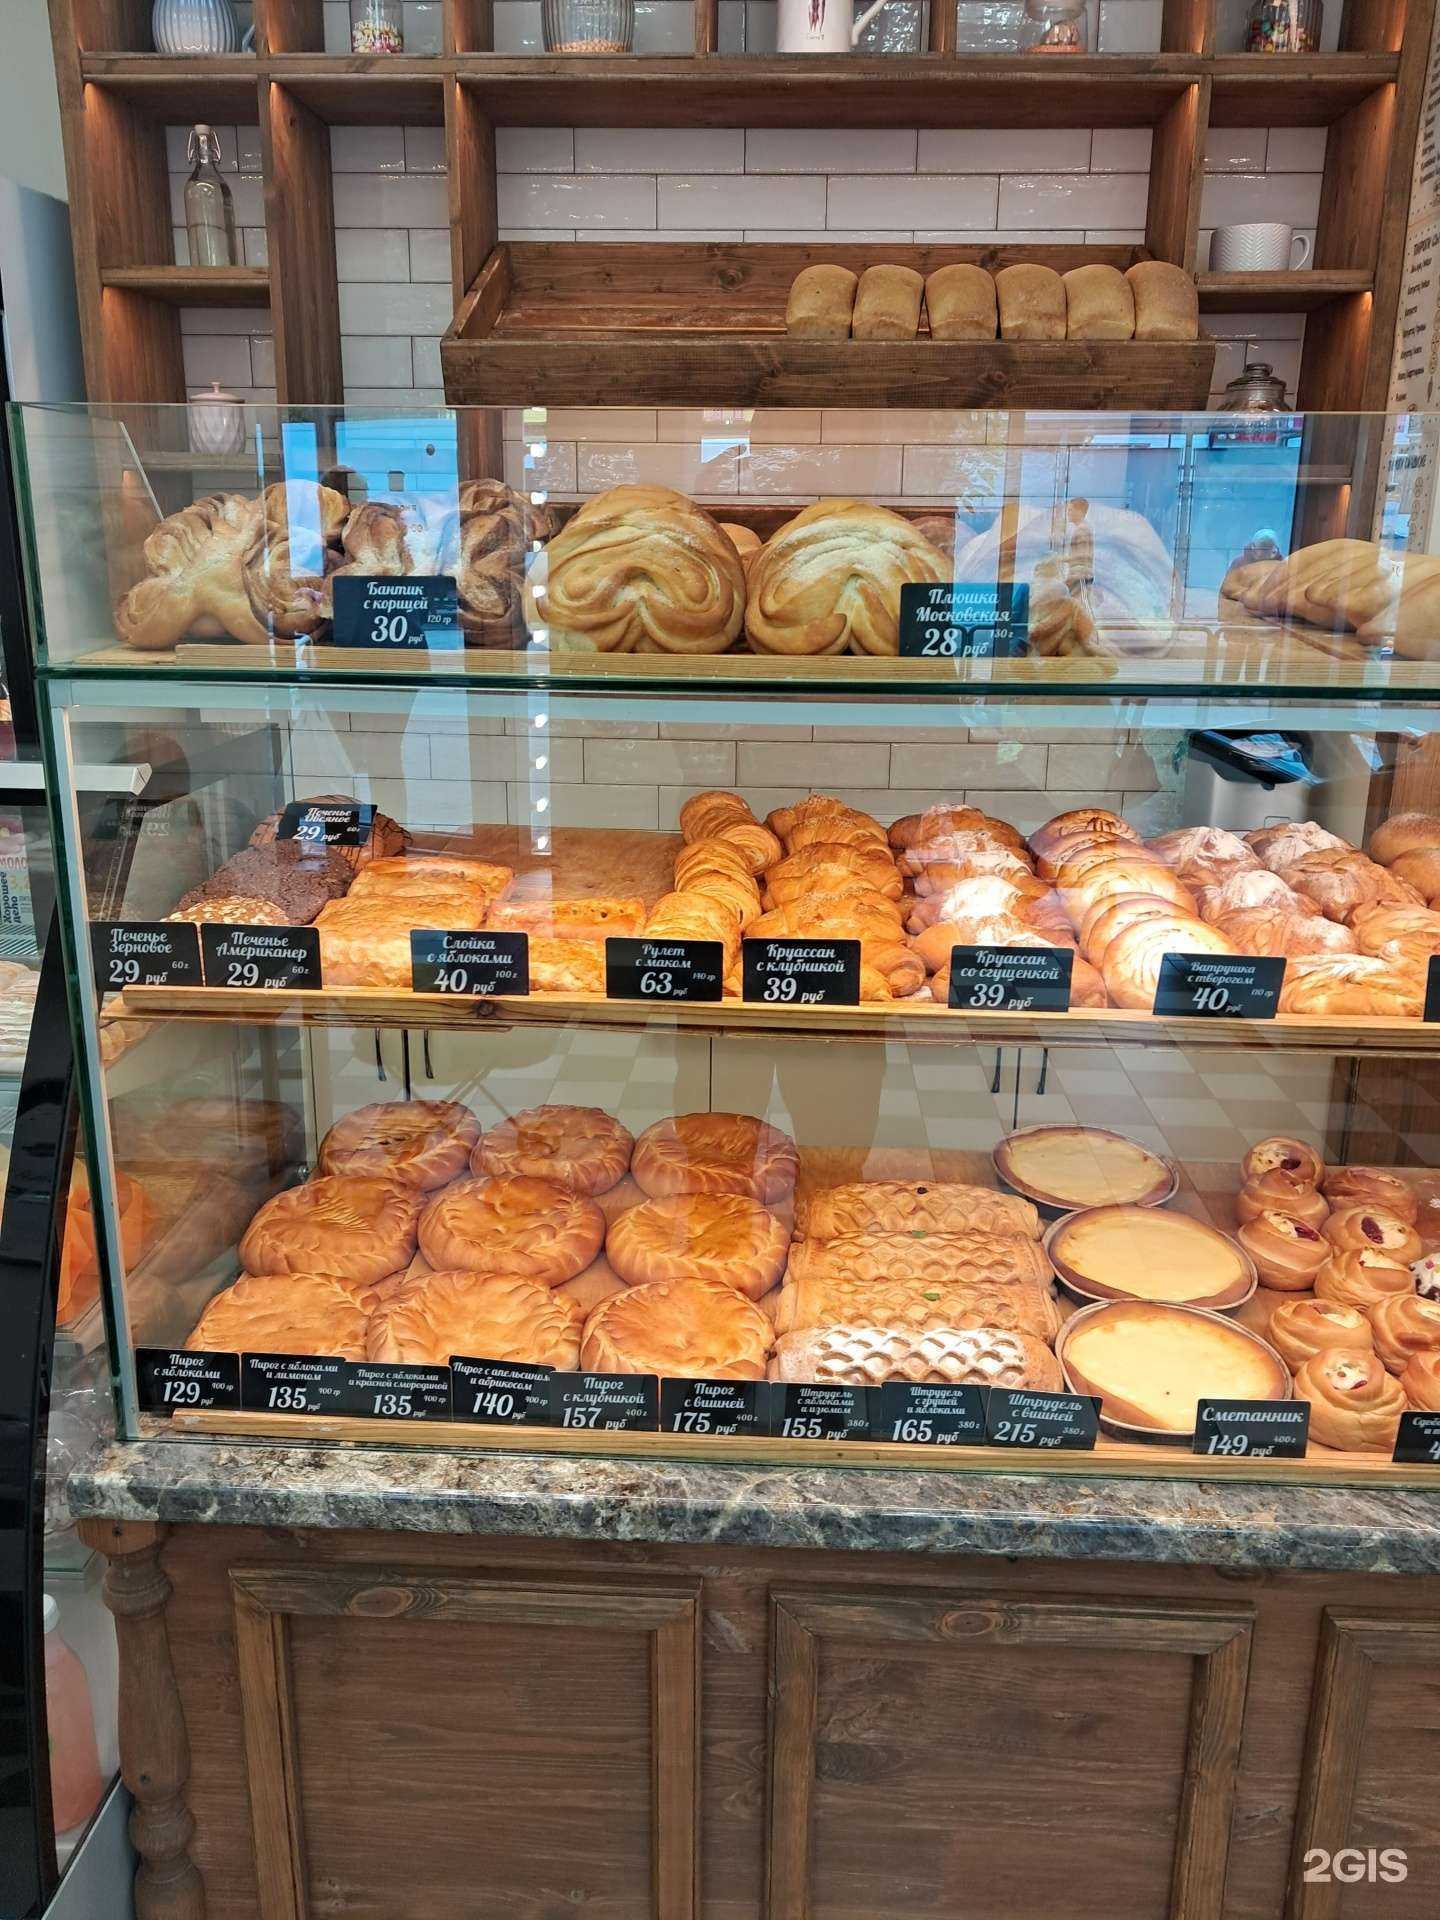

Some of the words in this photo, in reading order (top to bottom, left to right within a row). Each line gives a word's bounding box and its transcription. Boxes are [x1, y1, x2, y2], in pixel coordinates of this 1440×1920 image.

[366, 581, 425, 596] Бантик
[928, 588, 1000, 605] Плюшка
[363, 600, 370, 609] с
[372, 597, 429, 613] корицей
[427, 614, 442, 623] 120
[915, 606, 1012, 622] Московская
[370, 615, 408, 642] 30
[407, 633, 425, 644] руб
[921, 628, 958, 656] 28
[962, 641, 989, 658] руб
[292, 825, 322, 841] 29
[320, 833, 342, 842] руб
[0, 871, 13, 924] Хорошее
[110, 928, 168, 942] Печенье
[230, 931, 289, 947] Печенье
[442, 935, 497, 950] Слойка
[109, 939, 173, 956] Зерновое
[215, 942, 308, 962] Американер
[642, 943, 685, 959] Рулет
[766, 943, 837, 962] Круассан
[426, 953, 436, 963] с
[436, 950, 513, 964] яблоками
[635, 958, 643, 967] с
[643, 958, 692, 969] маком
[975, 950, 1047, 968] Круассан
[109, 959, 141, 983] 29
[145, 971, 168, 986] руб
[226, 962, 260, 987] 29
[263, 976, 288, 989] руб
[495, 970, 512, 979] 100
[756, 961, 765, 971] с
[766, 959, 846, 976] клубникой
[960, 967, 977, 977] со
[979, 967, 1061, 982] сгущенкой
[1190, 961, 1257, 976] Ватрушка
[433, 968, 468, 992] 40
[472, 981, 496, 994] руб
[640, 971, 673, 994] 63
[1187, 975, 1194, 983] с
[1195, 973, 1255, 986] творогом
[763, 977, 797, 1002] 39
[800, 989, 826, 1004] руб
[969, 983, 1005, 1007] 39
[1007, 996, 1035, 1010] руб
[1191, 987, 1230, 1011] 40
[169, 1353, 206, 1369] Пирог
[249, 1358, 280, 1372] Пирог
[280, 1362, 286, 1370] с
[287, 1361, 339, 1373] яблоками
[153, 1367, 160, 1376] с
[161, 1365, 221, 1379] яблоками
[265, 1370, 273, 1379] и
[274, 1371, 322, 1381] лимоном
[357, 1368, 385, 1380] Пирог
[385, 1371, 391, 1379] с
[391, 1370, 439, 1381] яблоками
[453, 1361, 483, 1376] Пирог
[484, 1368, 491, 1376] с
[491, 1368, 551, 1382] апельсином
[355, 1378, 393, 1389] красной
[392, 1380, 449, 1392] смородиной
[470, 1376, 478, 1385] и
[477, 1376, 534, 1391] абрикосом
[583, 1376, 625, 1392] Пирог
[693, 1382, 736, 1398] Пирог
[163, 1381, 201, 1404] 129
[268, 1386, 307, 1409] 135
[563, 1393, 571, 1402] с
[571, 1391, 646, 1406] клубникой
[799, 1387, 854, 1400] Штрудель
[909, 1386, 965, 1399] Штрудель
[373, 1394, 412, 1416] 135
[472, 1392, 515, 1417] 140
[683, 1397, 693, 1408] с
[692, 1395, 746, 1409] вишней
[803, 1396, 856, 1407] яблоками
[921, 1397, 959, 1408] грушей
[1007, 1393, 1083, 1412] Штрудель
[562, 1406, 602, 1429] 157
[604, 1418, 629, 1431] руб
[808, 1406, 852, 1416] изюмом
[914, 1406, 967, 1416] яблоками
[1011, 1408, 1021, 1418] с
[1020, 1406, 1075, 1422] вишней
[1202, 1407, 1305, 1423] Сметанник
[672, 1411, 712, 1434] 175
[714, 1423, 739, 1436] руб
[782, 1417, 823, 1438] 155
[825, 1429, 849, 1441] руб
[891, 1419, 933, 1442] 165
[935, 1431, 960, 1445] руб
[993, 1420, 1038, 1443] 215
[1039, 1435, 1064, 1447] руб
[1207, 1434, 1249, 1456] 149
[1250, 1445, 1275, 1457] руб
